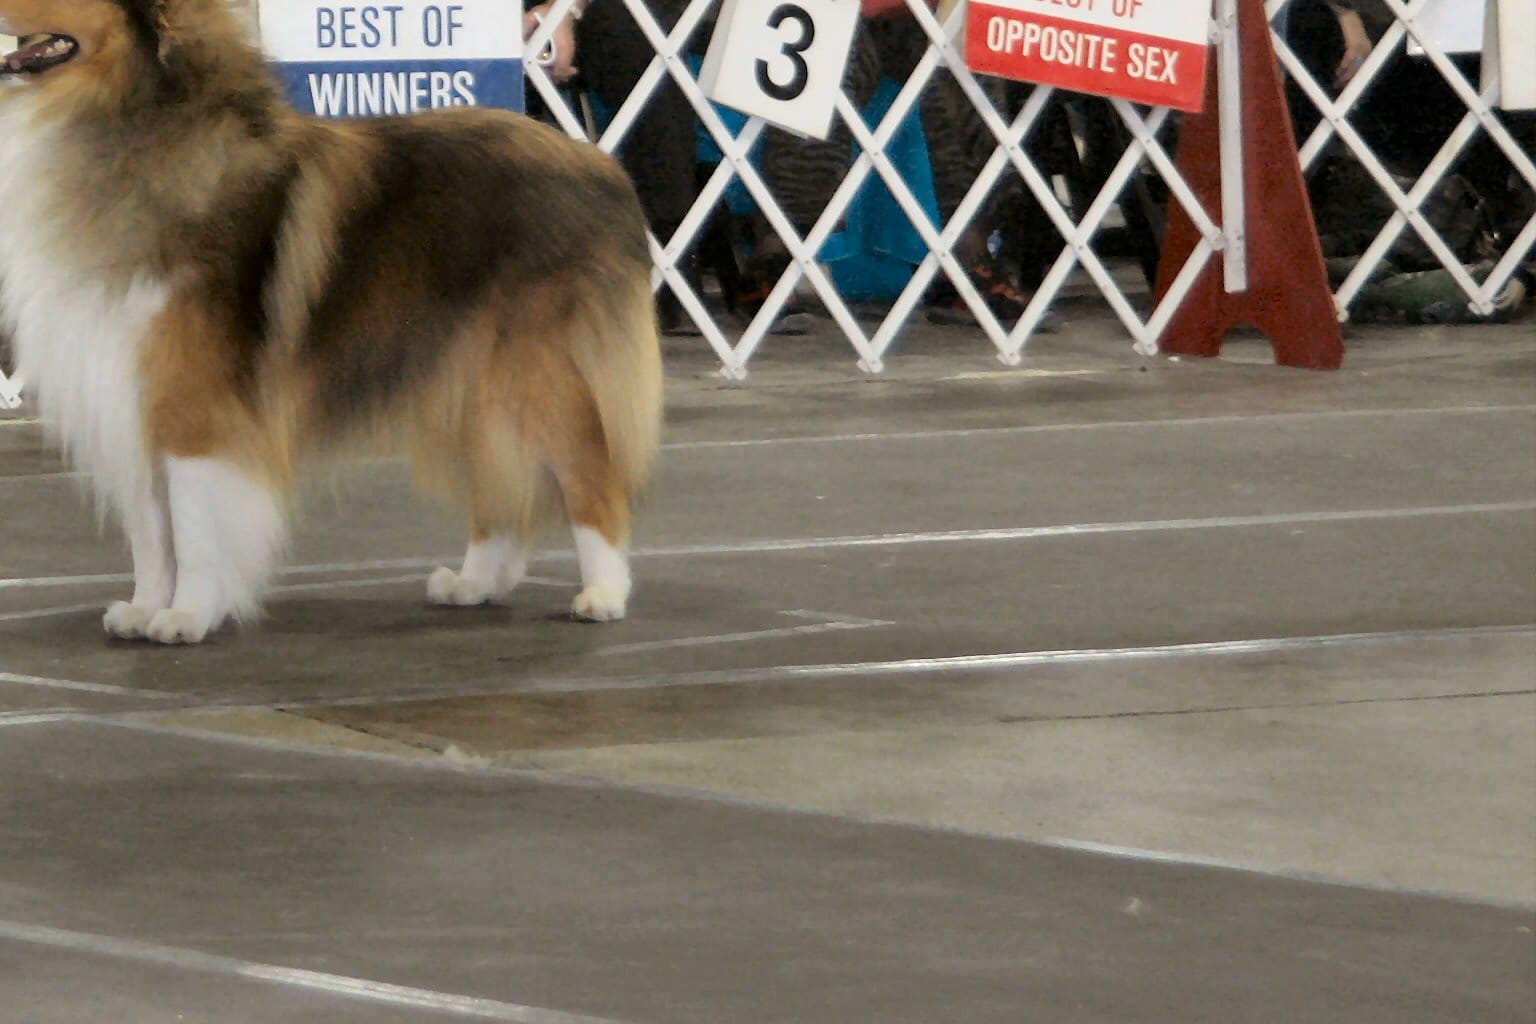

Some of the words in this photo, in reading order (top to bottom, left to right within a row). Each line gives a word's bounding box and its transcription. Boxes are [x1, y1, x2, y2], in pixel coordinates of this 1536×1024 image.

[316, 5, 403, 48] BEST
[422, 5, 463, 47] OF
[754, 3, 815, 101] 3
[987, 16, 1117, 73] OPPOSITE
[1127, 43, 1180, 85] SEX
[308, 71, 476, 117] WINNERS
